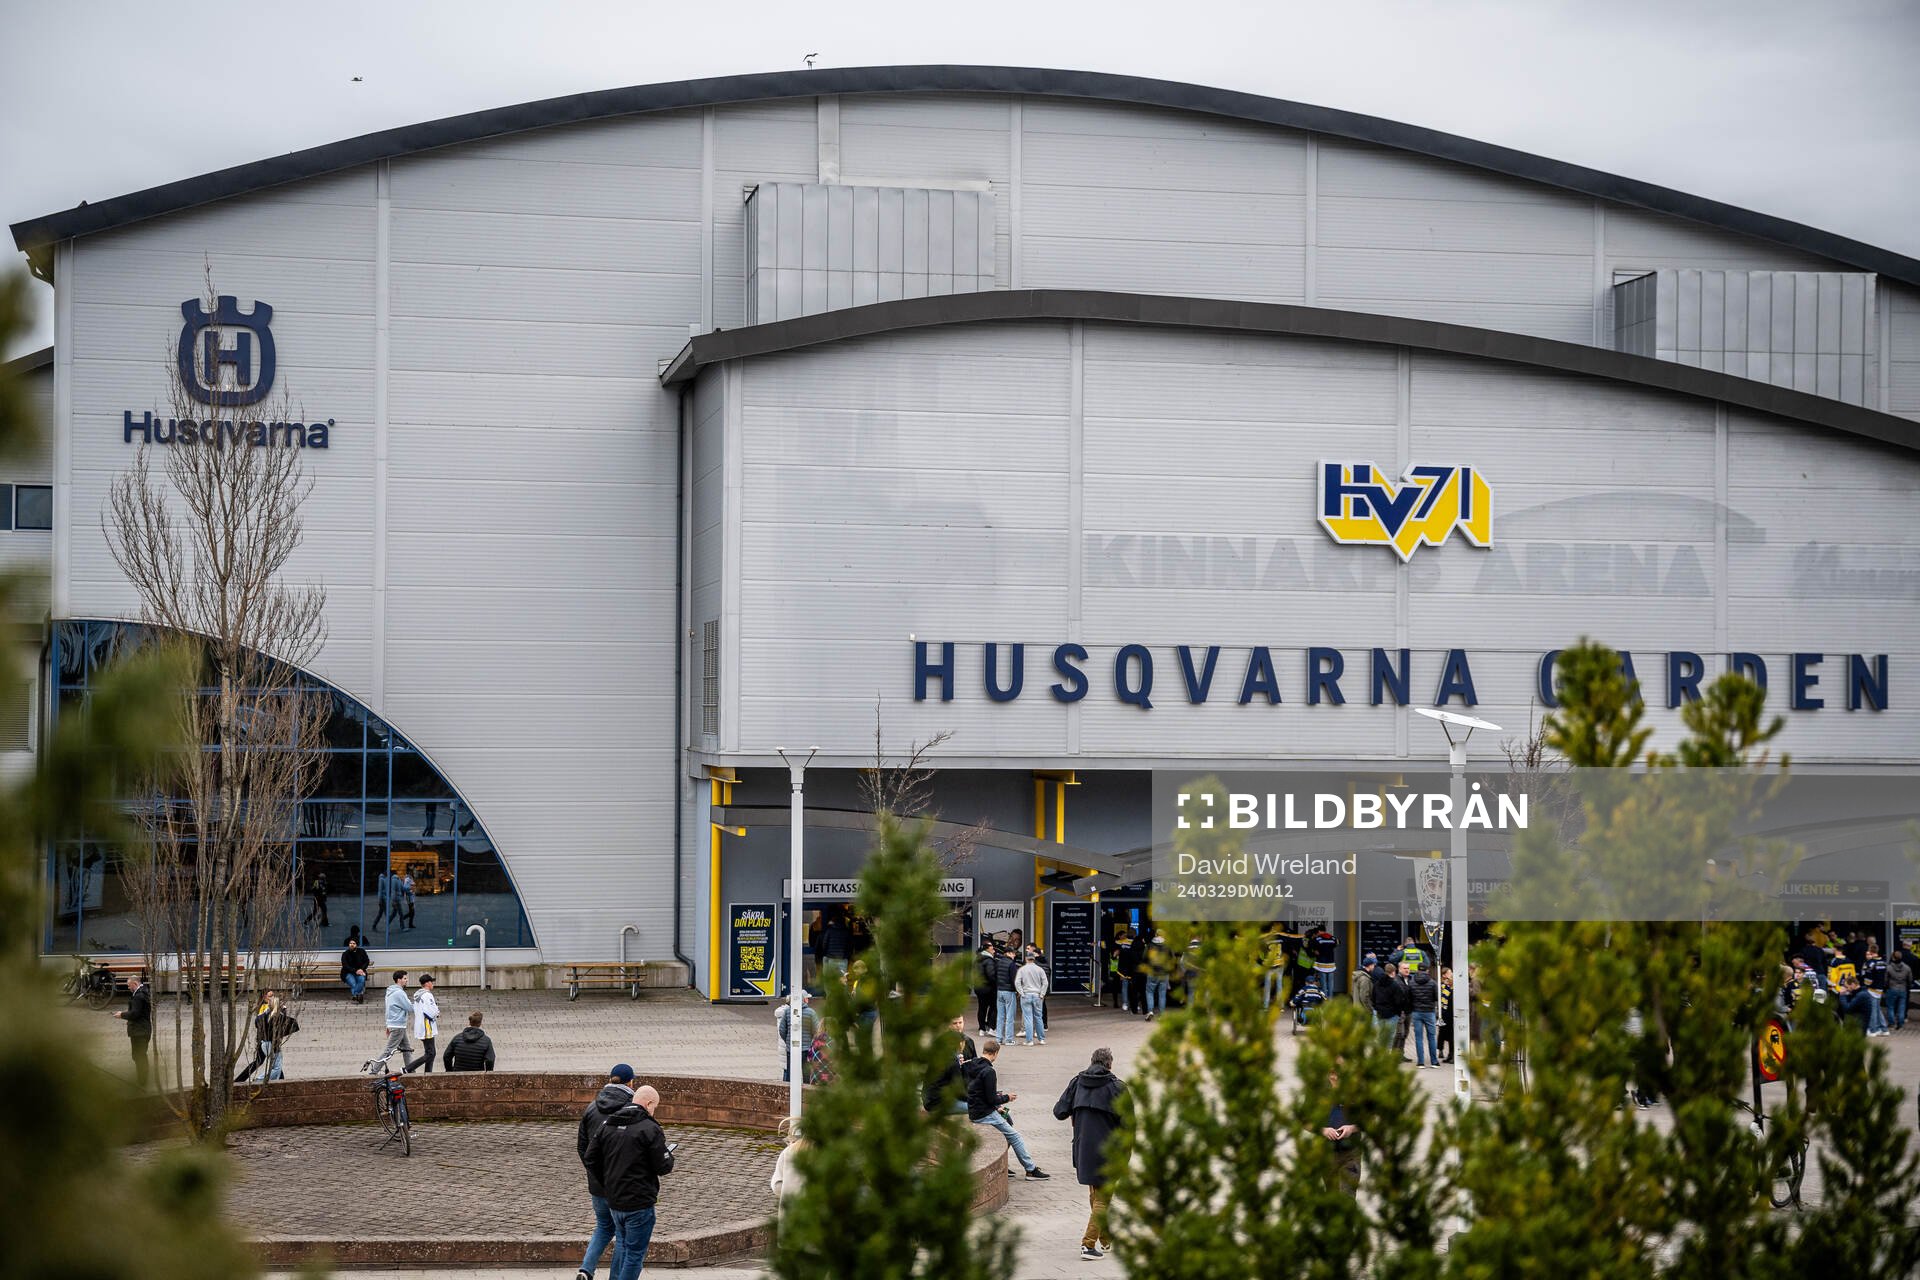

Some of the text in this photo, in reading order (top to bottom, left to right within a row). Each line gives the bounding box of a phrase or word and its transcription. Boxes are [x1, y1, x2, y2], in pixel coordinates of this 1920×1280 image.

[1321, 460, 1476, 542] HV71
[1471, 542, 1712, 597] ARENA
[913, 641, 1479, 709] HUSQVARNA
[802, 883, 862, 893] LJETTKASS
[1779, 881, 1839, 895] LIKENTRÉ
[985, 909, 1019, 919] HEJA HV!
